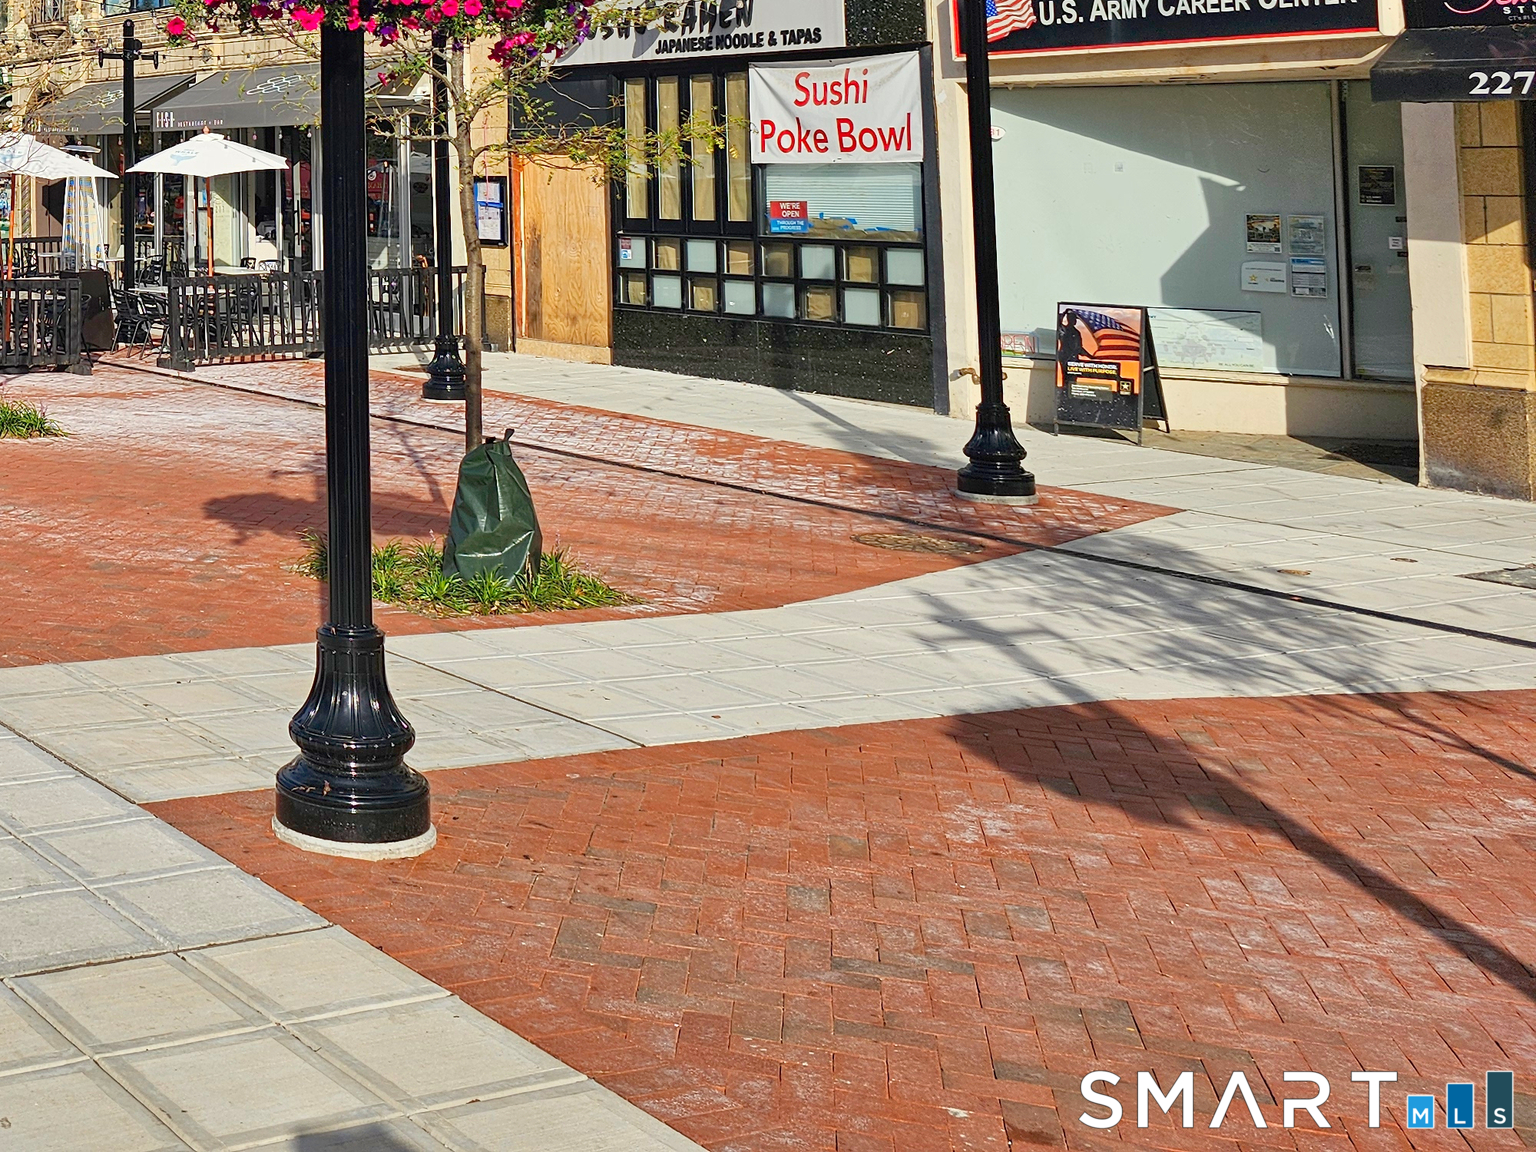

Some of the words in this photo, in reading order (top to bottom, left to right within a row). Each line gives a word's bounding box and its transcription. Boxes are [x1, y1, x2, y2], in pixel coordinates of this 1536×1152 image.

[655, 35, 714, 55] JAPANESE
[715, 29, 764, 51] NOODLE
[767, 30, 778, 46] &
[780, 27, 822, 46] TAPAS
[793, 68, 869, 107] Sushi
[1468, 71, 1536, 95] 227
[760, 116, 829, 154] Poke
[835, 112, 912, 153] Bowl
[779, 202, 801, 210] WE'RE
[781, 210, 800, 218] OPEN
[1001, 333, 1036, 355] PEN
